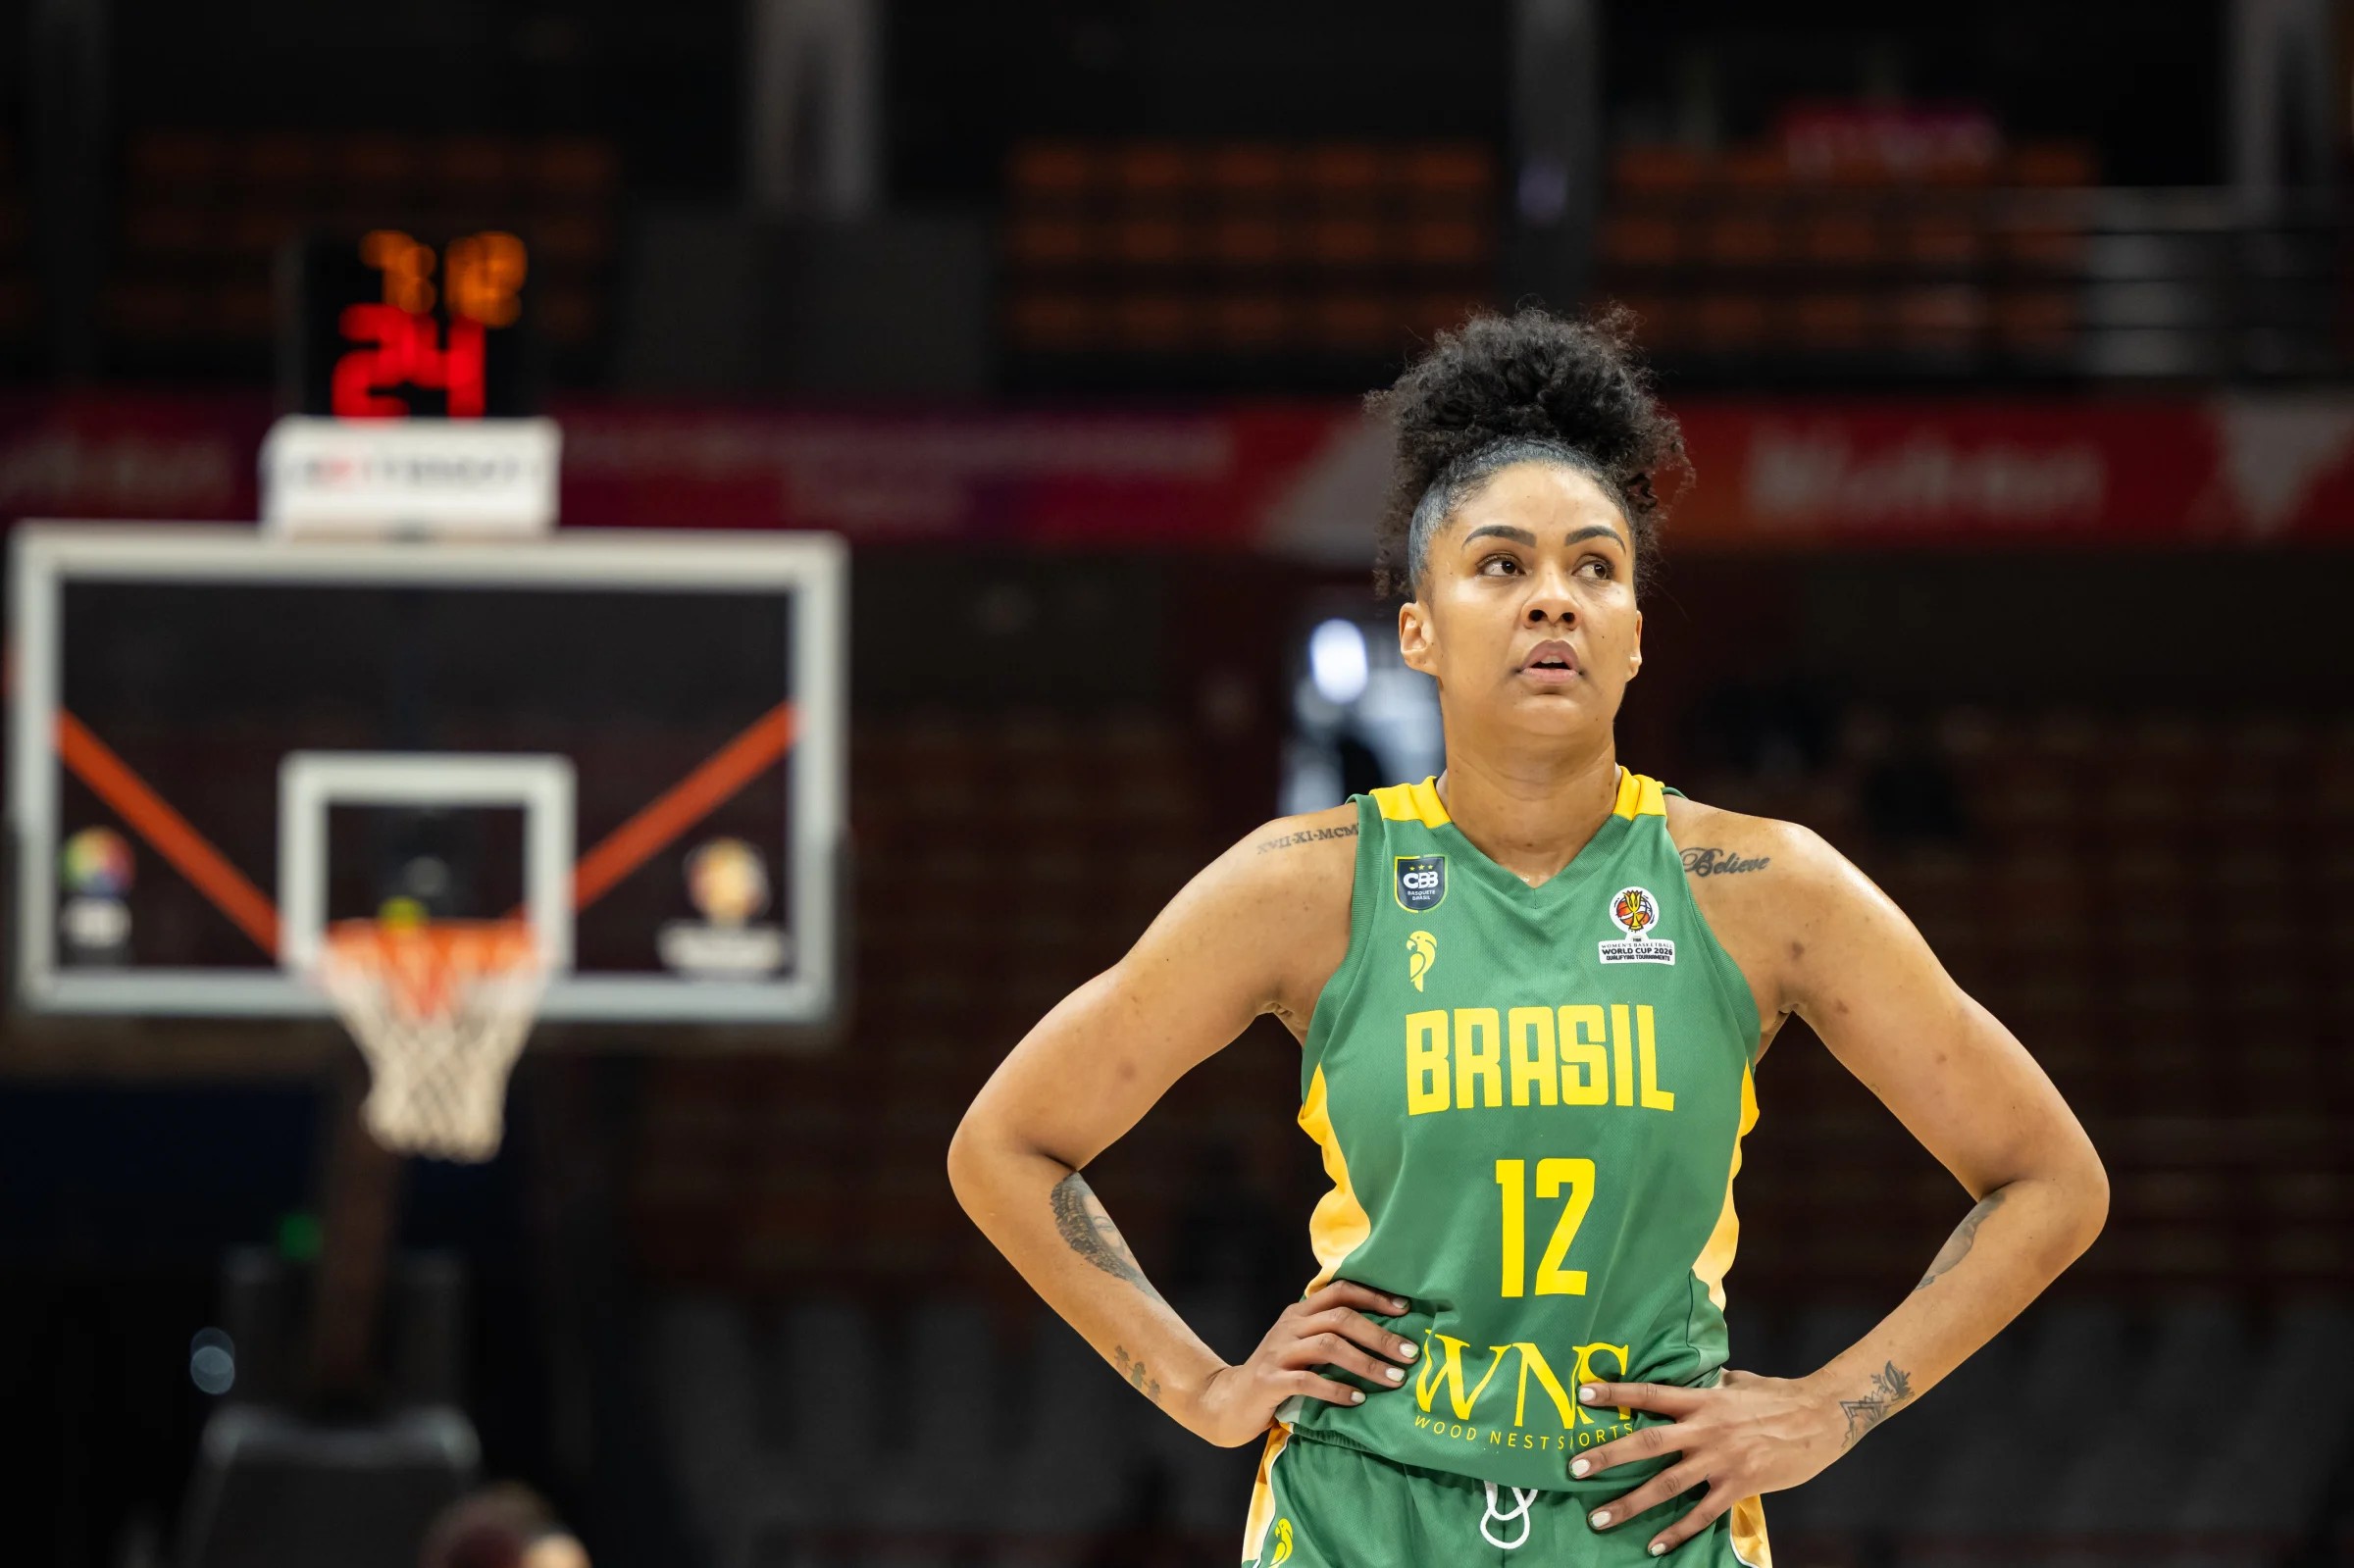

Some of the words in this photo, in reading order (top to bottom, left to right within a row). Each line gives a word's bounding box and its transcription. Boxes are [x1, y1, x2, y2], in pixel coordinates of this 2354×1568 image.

[332, 303, 486, 425] 24
[1403, 871, 1439, 889] CBB
[1679, 847, 1770, 878] Believe
[1406, 1004, 1675, 1116] BRASIL
[1496, 1158, 1596, 1297] 12
[1414, 1415, 1477, 1442] WOOD
[1490, 1431, 1551, 1450] NEST
